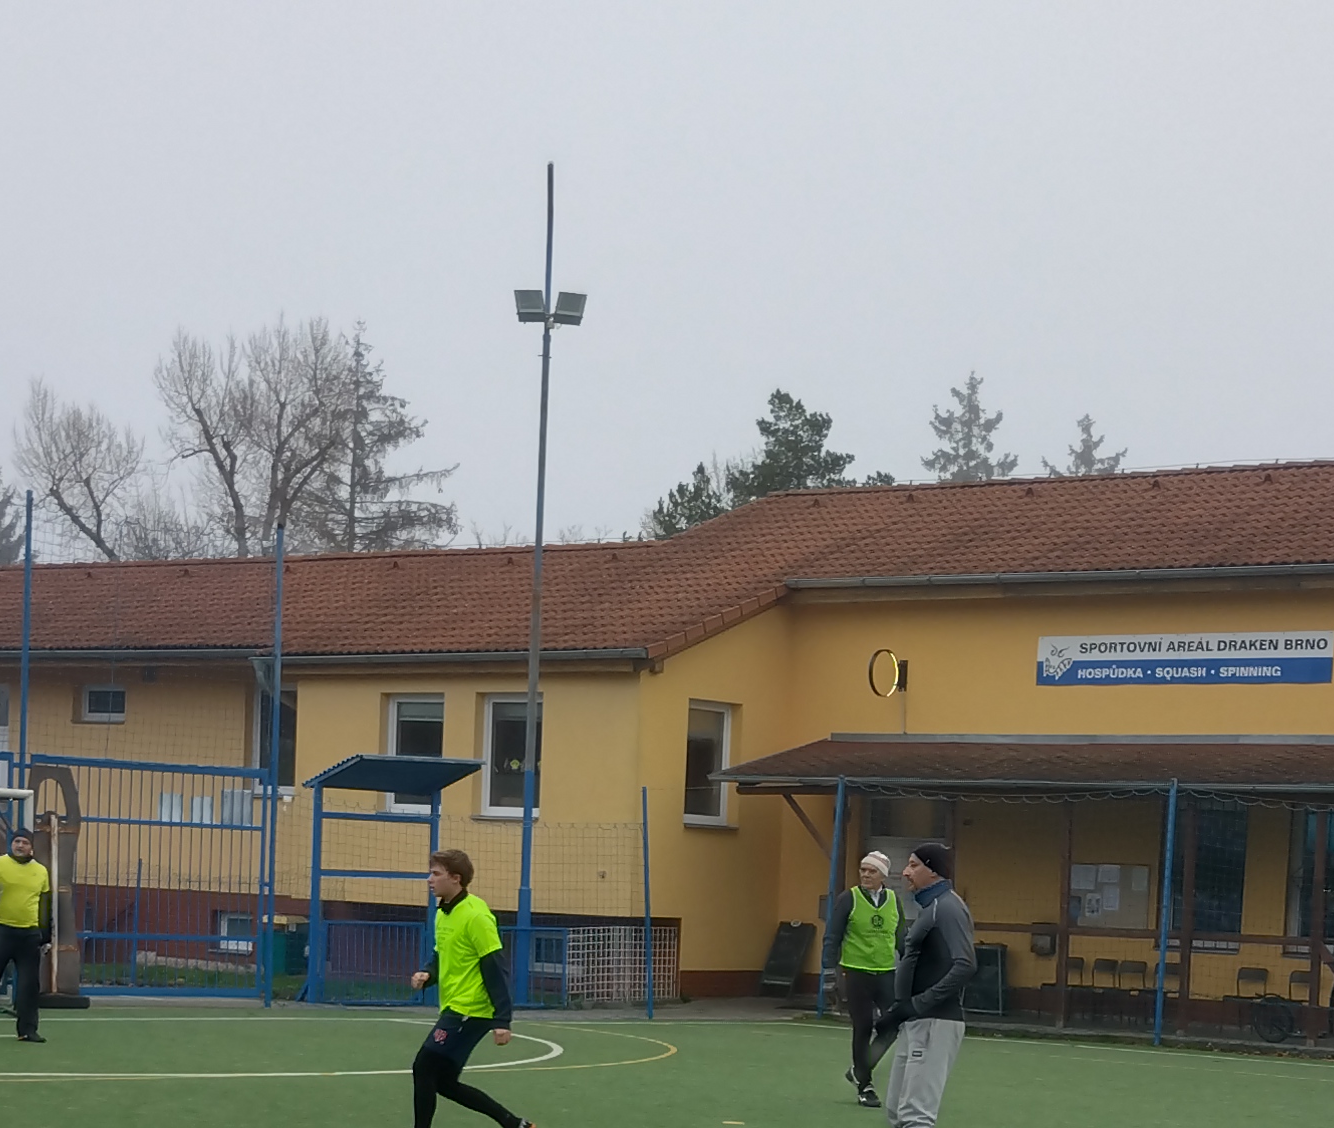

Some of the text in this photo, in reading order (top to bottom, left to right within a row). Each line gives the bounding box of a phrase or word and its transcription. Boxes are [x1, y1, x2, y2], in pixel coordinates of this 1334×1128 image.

[1079, 637, 1328, 654] SPORTOVNÍ AREÁL DRAKEN BRNO
[1077, 664, 1281, 680] HOSPŮDKA SQUASH SPINNING
